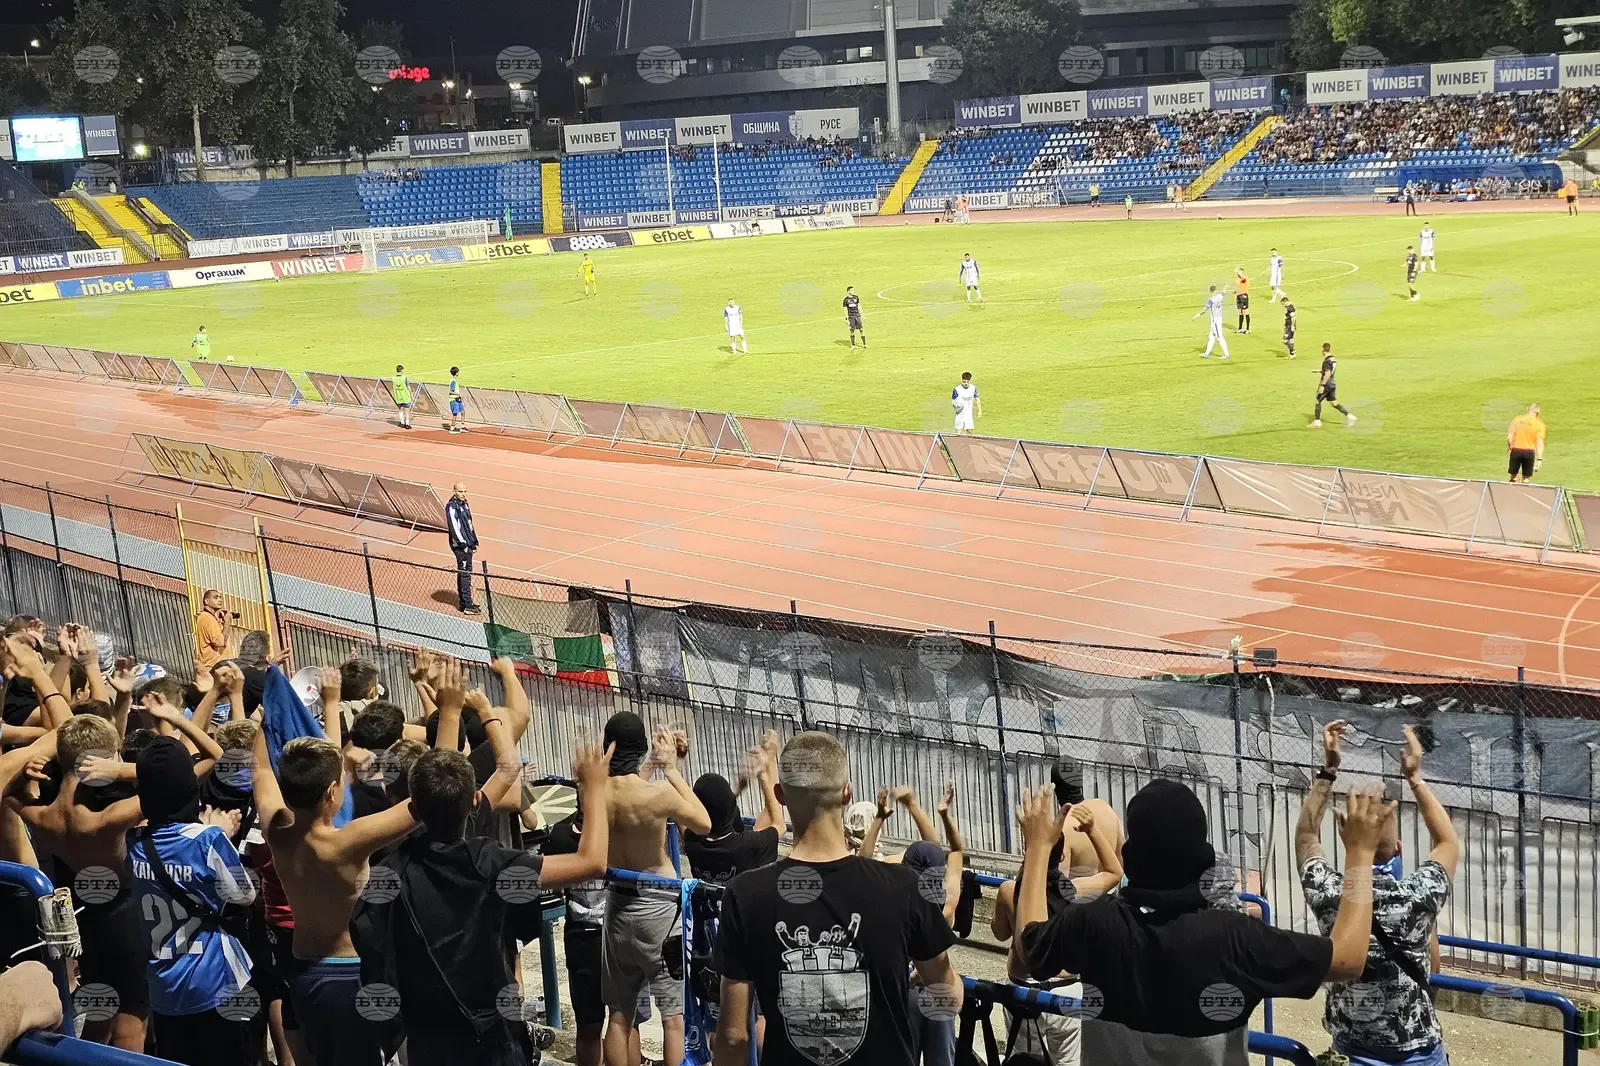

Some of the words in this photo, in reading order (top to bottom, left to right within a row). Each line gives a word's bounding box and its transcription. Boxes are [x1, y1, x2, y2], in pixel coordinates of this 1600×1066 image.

[1436, 71, 1489, 86] WINBET
[1499, 66, 1554, 82] WINBET
[1312, 80, 1362, 94] WINBET
[1372, 75, 1425, 91] WINBET
[1153, 91, 1205, 107] WINBET
[1214, 86, 1267, 102] WINBET
[1026, 100, 1081, 114] WINBET
[1091, 96, 1143, 111] WINBET
[961, 104, 1014, 120] WINBET
[85, 129, 116, 138] WINBET
[680, 124, 727, 138] WINBET
[743, 120, 780, 135] ОБЩИНА
[820, 118, 841, 130] РУСЕ
[474, 134, 523, 147] WINBET
[570, 132, 617, 144] WINBET
[625, 128, 672, 141] WINBET
[414, 137, 464, 151] WINBET
[1011, 191, 1054, 204] WINBET
[728, 207, 770, 218] WINBET
[779, 204, 823, 216] WINBET
[832, 201, 873, 213] WINBET
[584, 215, 624, 227] WINBET
[632, 213, 671, 224] WINBET
[679, 211, 719, 222] WINBET
[341, 230, 386, 242] WINBET
[451, 223, 495, 235] WINBET
[652, 228, 695, 243] efbet
[242, 237, 283, 249] WINBET
[292, 233, 333, 246] WINBET
[73, 250, 118, 264] WINBET
[485, 242, 532, 258] efbet
[18, 254, 64, 269] WINBET
[277, 256, 346, 276] WINBET
[141, 893, 204, 960] 22
